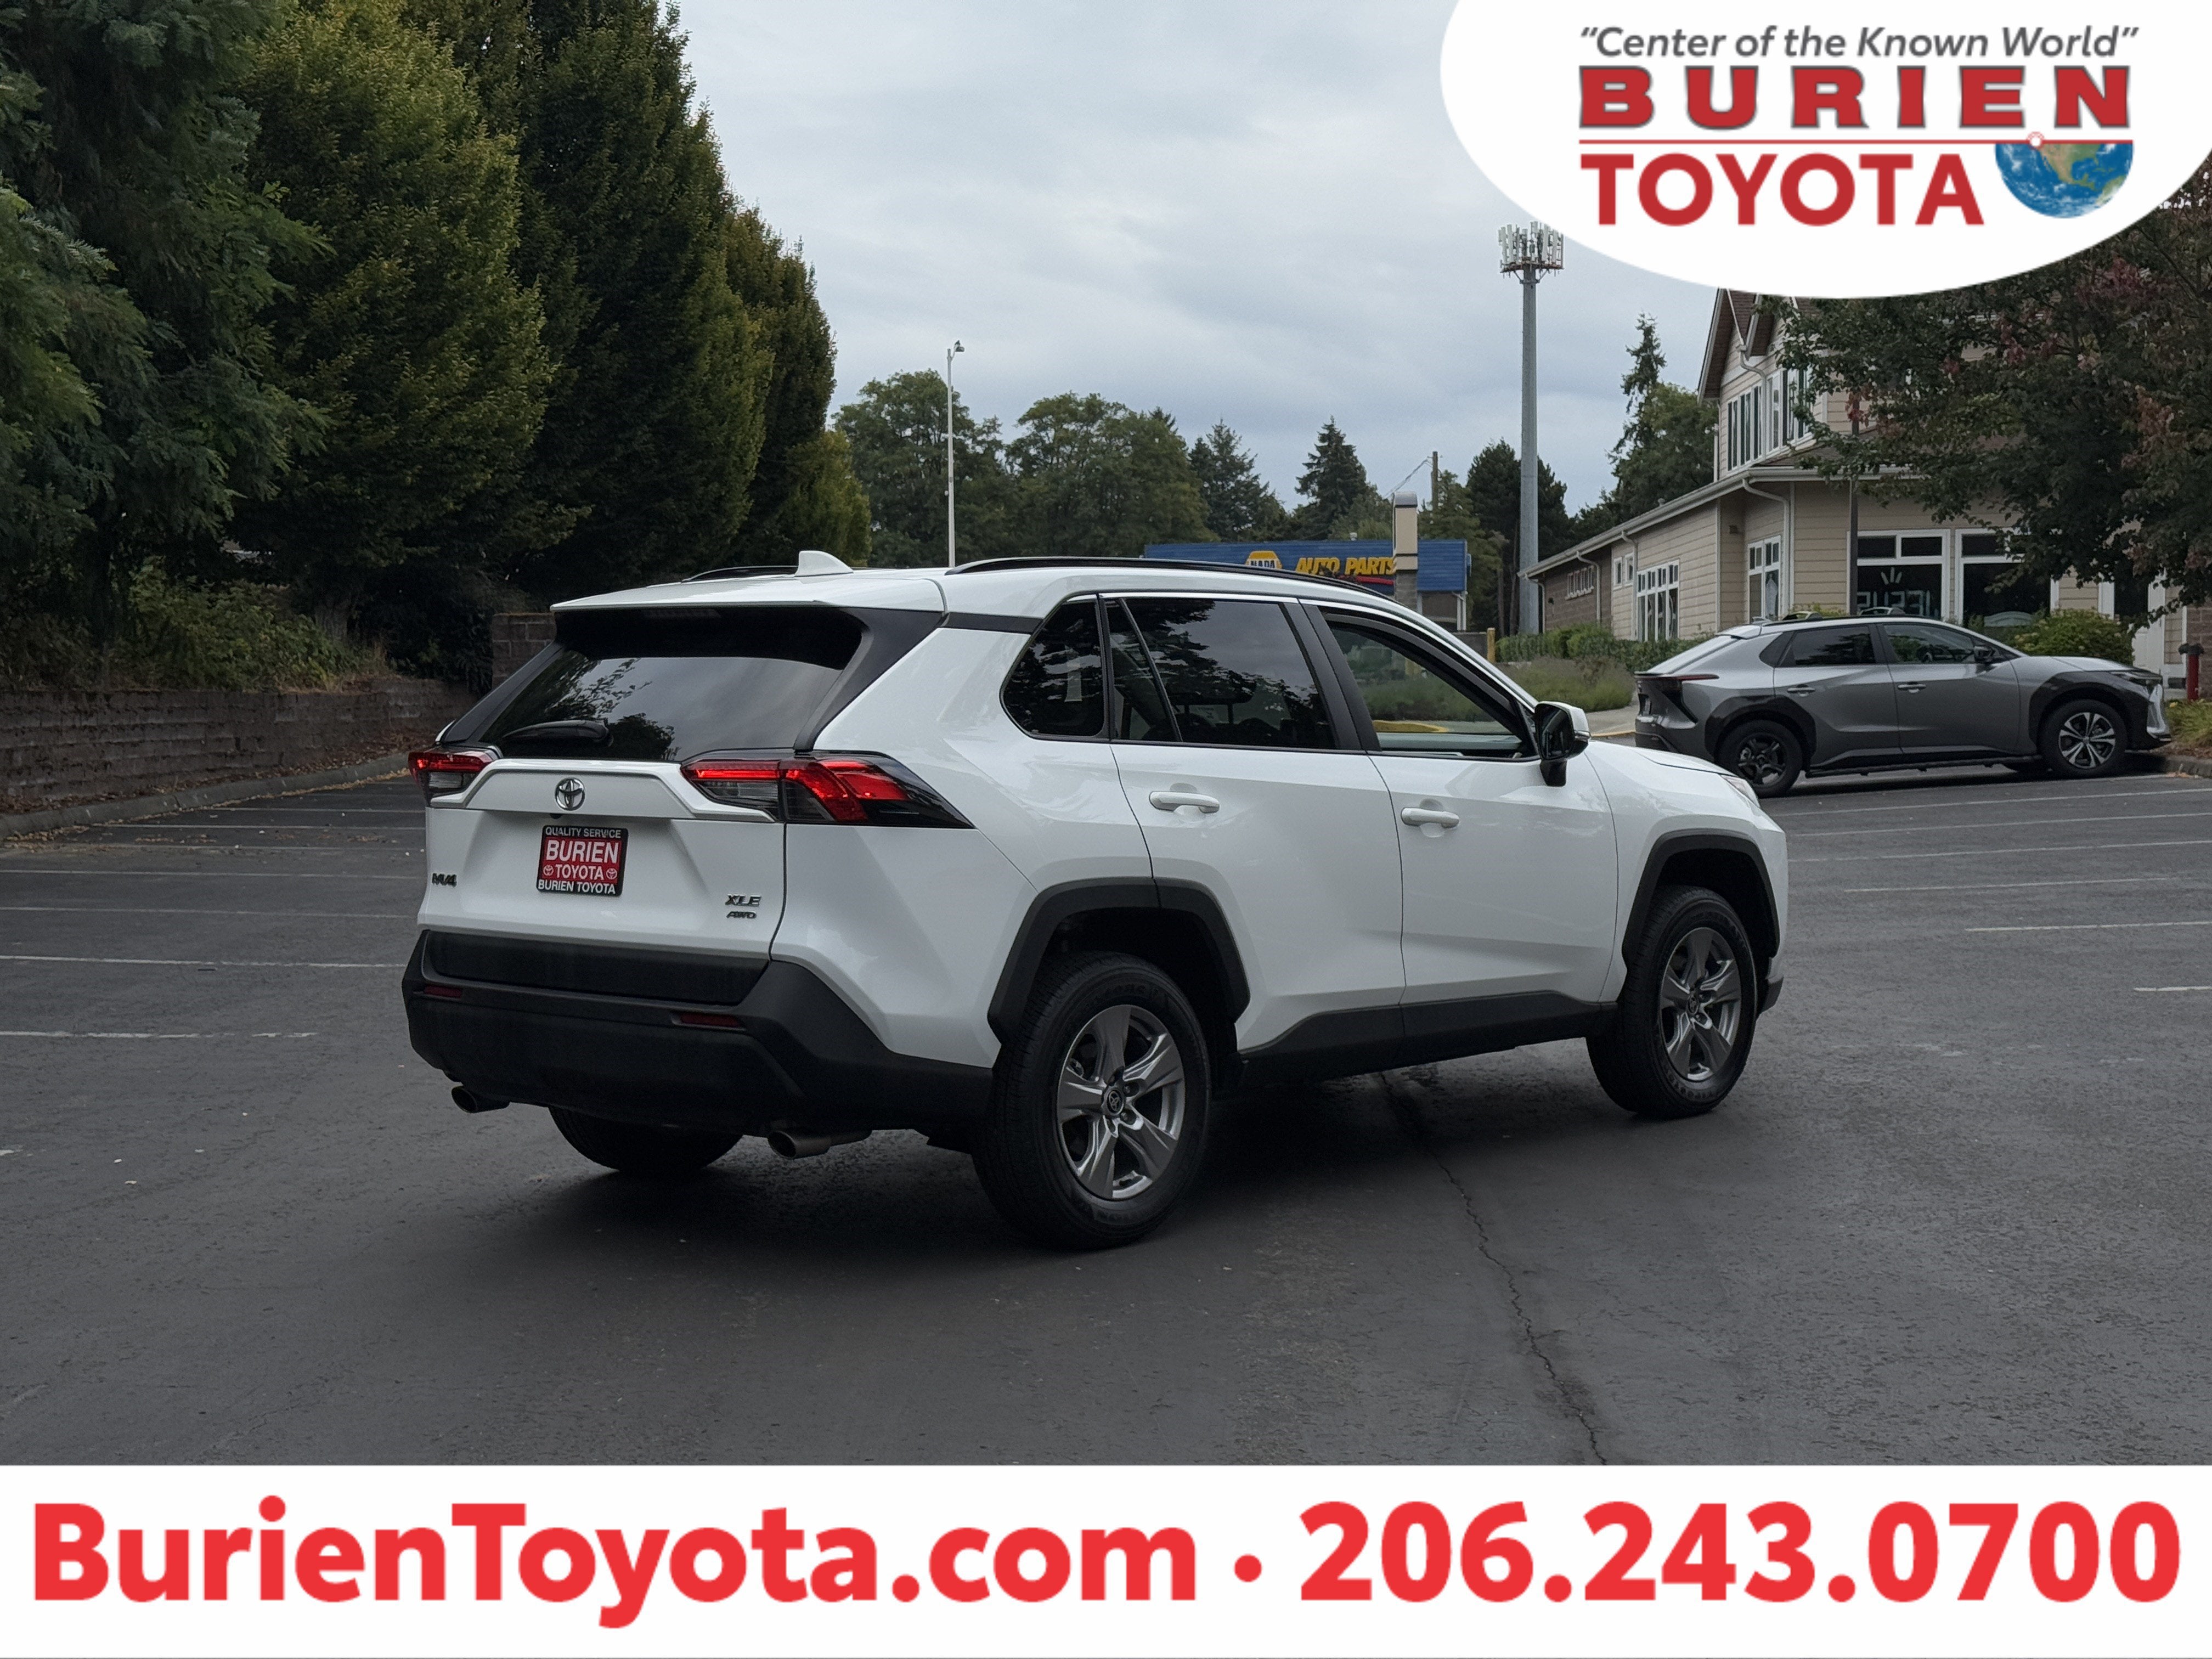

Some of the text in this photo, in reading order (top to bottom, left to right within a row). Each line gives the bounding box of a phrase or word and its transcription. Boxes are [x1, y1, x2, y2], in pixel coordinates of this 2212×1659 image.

[1295, 557, 1340, 575] AUTO
[545, 827, 622, 838] QUALITY SERVICE
[546, 839, 619, 864] BURIEN
[555, 864, 605, 881] TOYOTA
[538, 879, 616, 895] BURIEN TOYOTA
[725, 894, 761, 907] XLE
[726, 911, 757, 919] AWD
